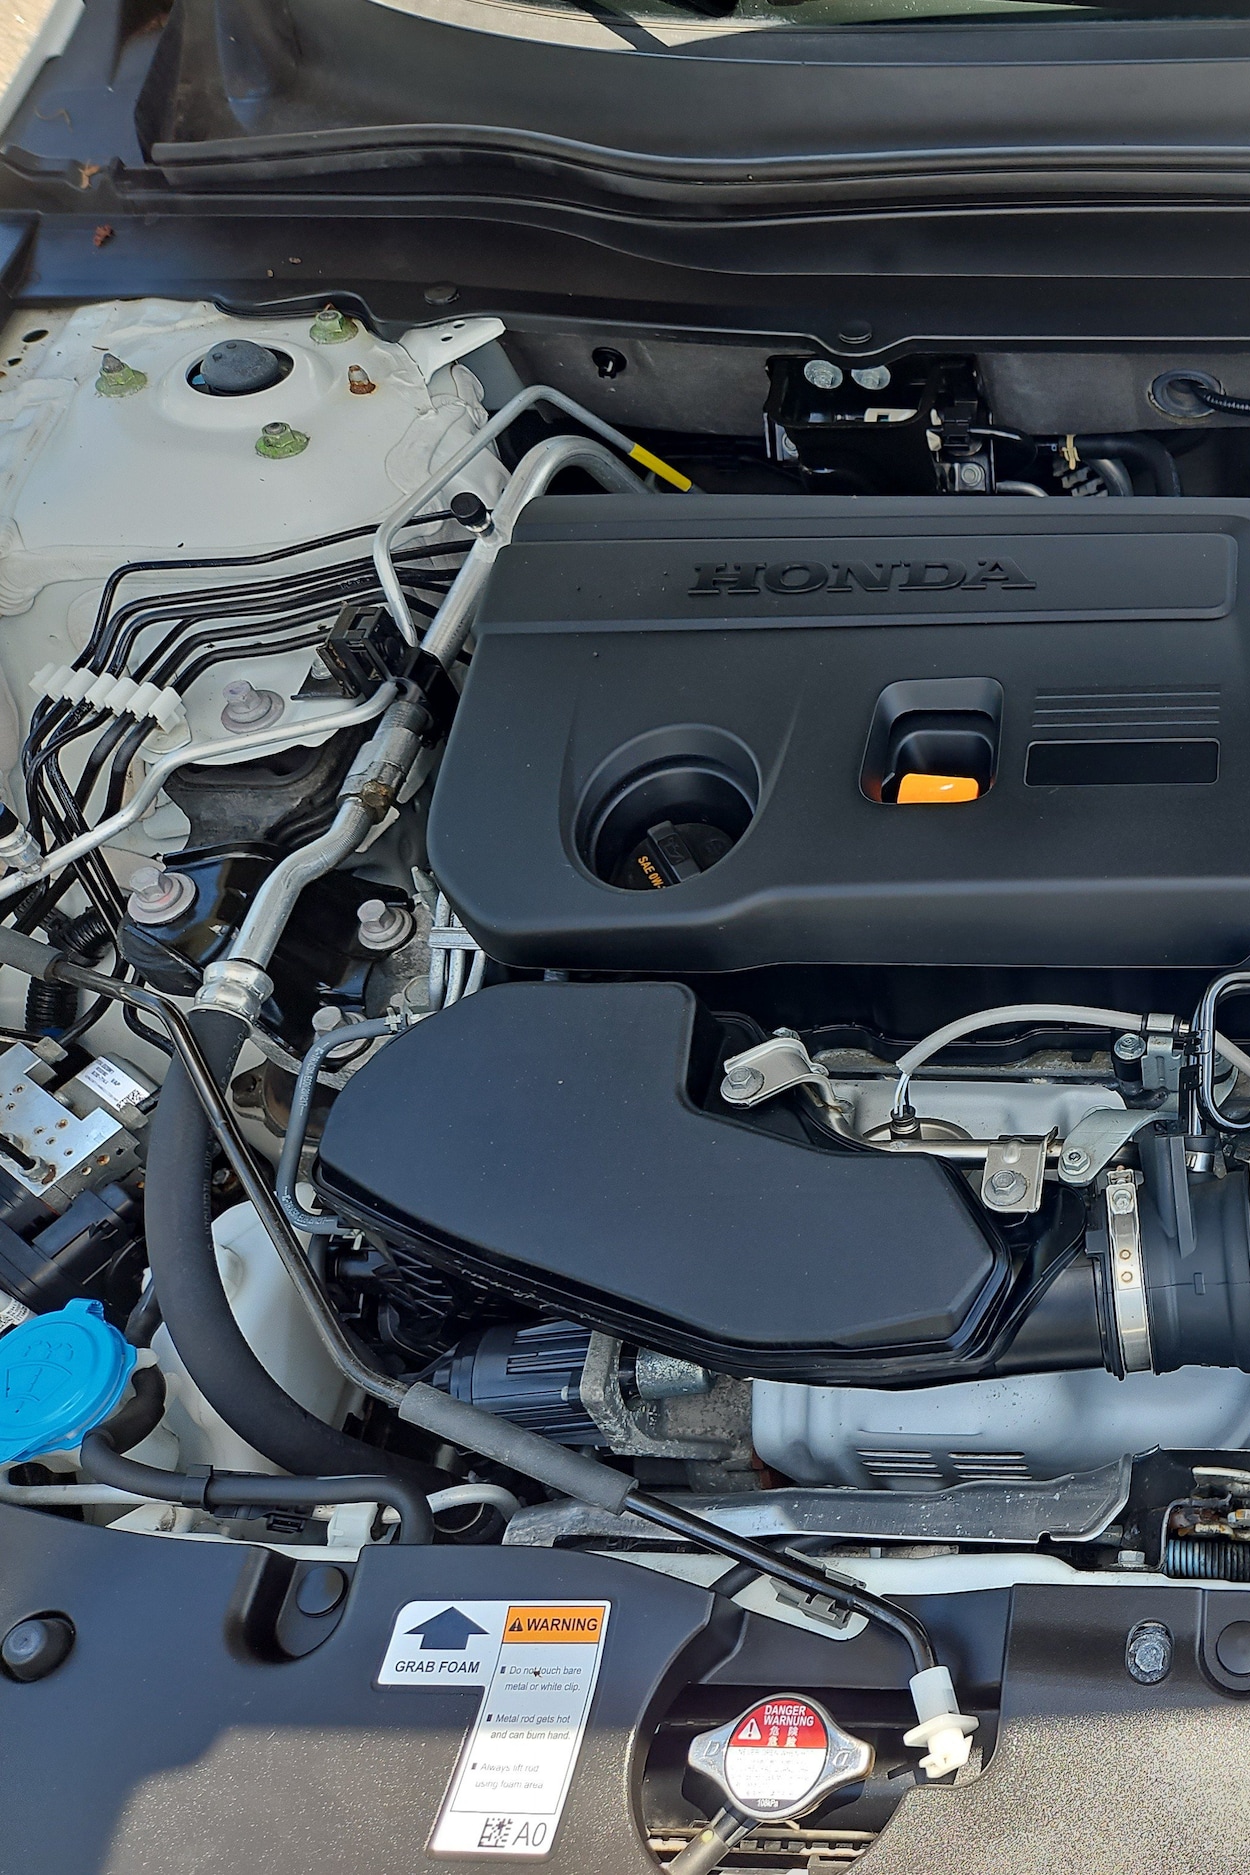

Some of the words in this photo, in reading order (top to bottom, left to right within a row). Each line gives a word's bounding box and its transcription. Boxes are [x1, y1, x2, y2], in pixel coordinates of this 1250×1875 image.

[687, 556, 1037, 595] HONDA
[638, 856, 655, 874] SAE
[648, 872, 666, 889] 0W-
[526, 1618, 598, 1632] WARNING
[394, 1660, 436, 1674] GRAB
[438, 1660, 480, 1674] FOAM
[509, 1666, 522, 1675] Do
[563, 1666, 582, 1675] bare
[504, 1682, 528, 1692] metal
[530, 1684, 540, 1692] or
[540, 1682, 563, 1692] white
[564, 1682, 581, 1693] clip.
[764, 1704, 806, 1716] DANGER
[495, 1714, 519, 1724] Metal
[521, 1714, 535, 1724] rod
[536, 1715, 555, 1725] gets
[556, 1714, 571, 1724] hot
[763, 1715, 815, 1727] WARNUNG
[490, 1730, 507, 1740] and
[509, 1731, 525, 1740] can
[547, 1731, 571, 1740] hand.
[480, 1763, 510, 1774] Always
[512, 1822, 547, 1847] A0
